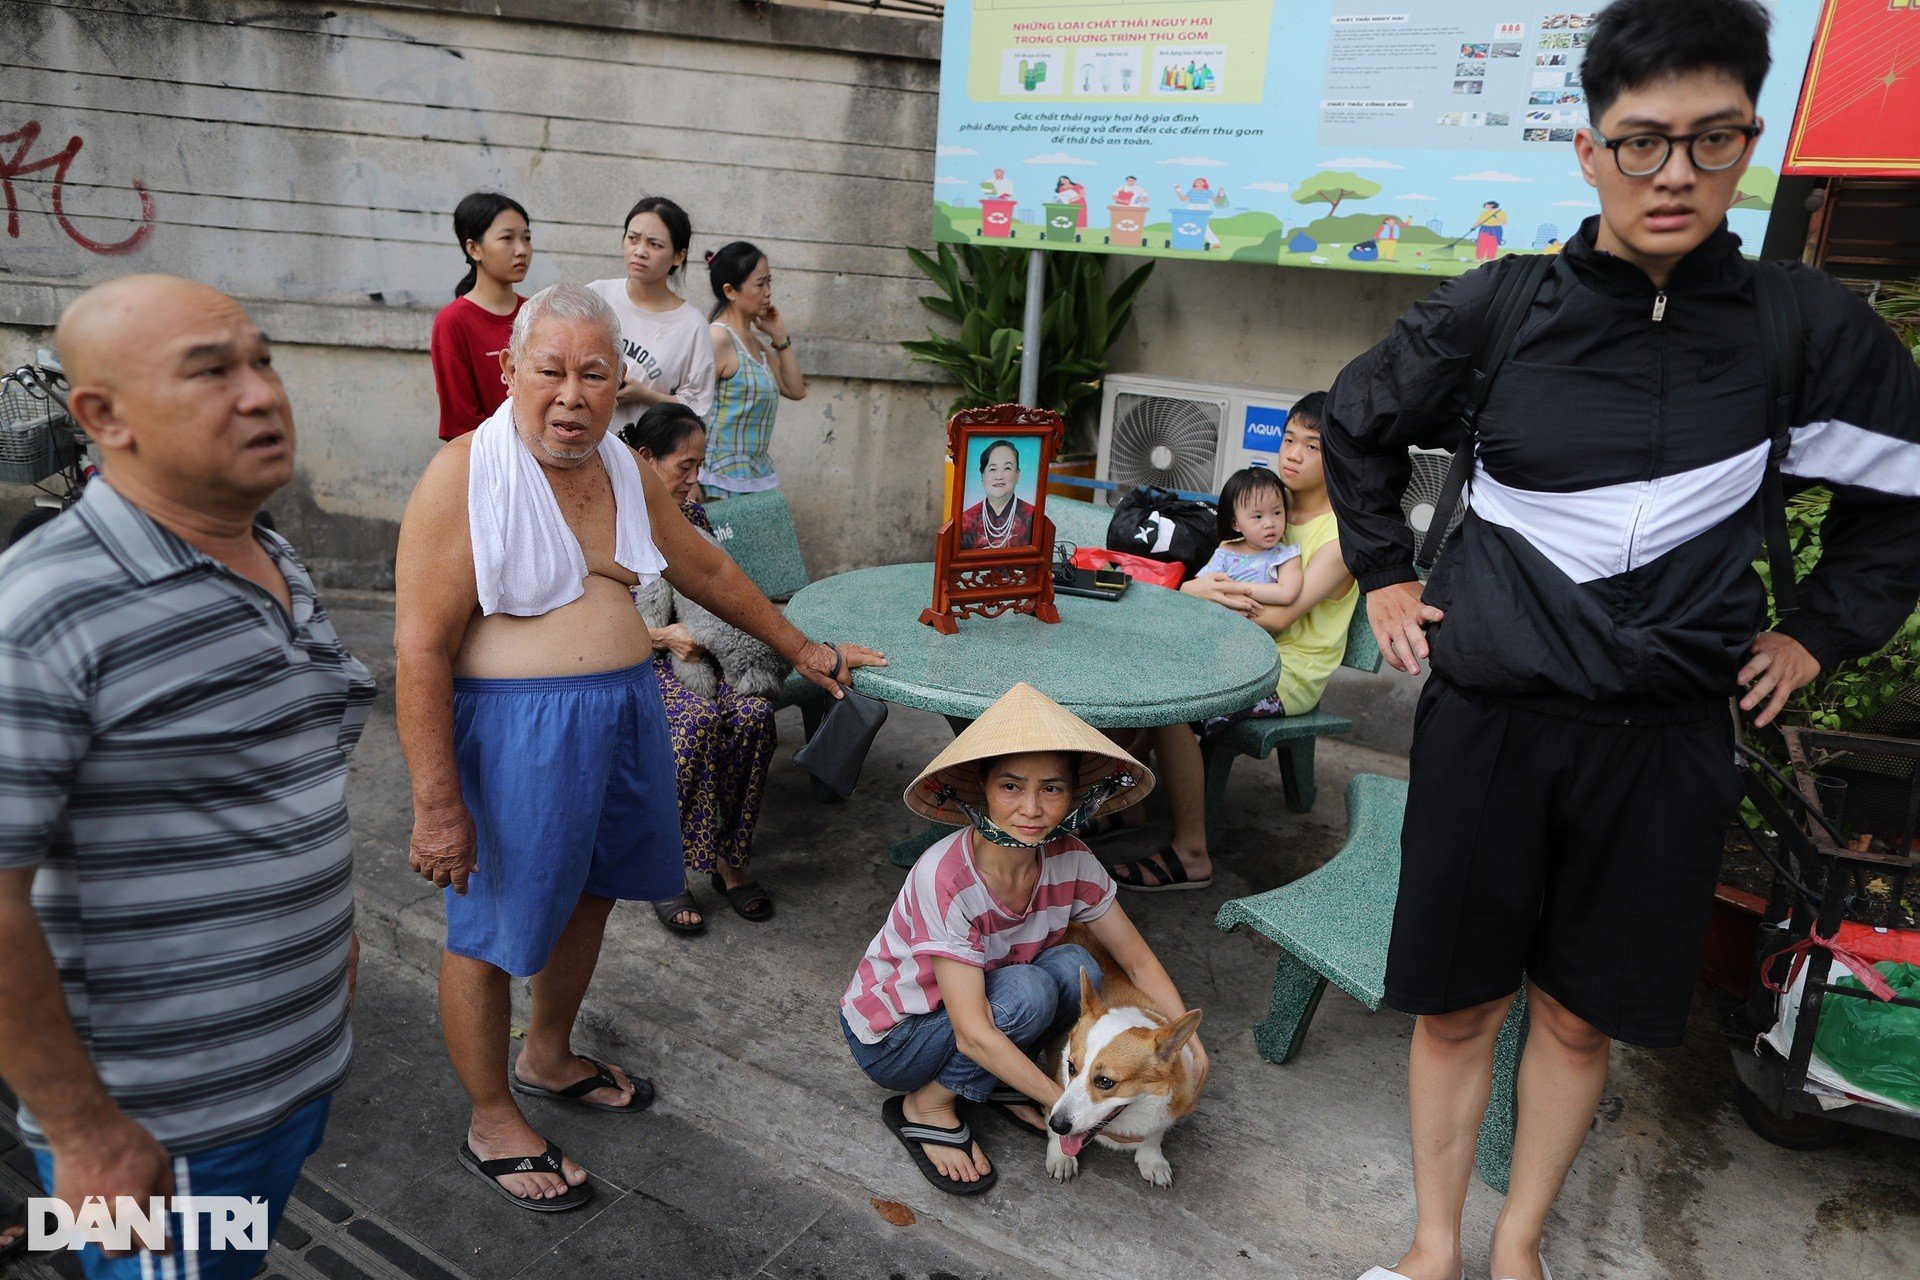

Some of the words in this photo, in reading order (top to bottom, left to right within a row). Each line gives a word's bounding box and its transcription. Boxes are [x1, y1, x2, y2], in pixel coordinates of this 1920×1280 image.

[1086, 18, 1117, 29] CHẤT
[1121, 17, 1148, 28] THẢI
[1151, 18, 1186, 27] NGUY
[1190, 17, 1213, 28] HẠI
[1015, 35, 1054, 43] TRONG
[1056, 34, 1108, 43] CHƯƠNG
[1110, 33, 1146, 41] TRÌNH
[1150, 32, 1175, 41] THU
[1177, 31, 1209, 41] GOM
[1014, 112, 1033, 120] Các
[1035, 112, 1058, 120] chất
[1061, 112, 1082, 120] thải
[1084, 114, 1111, 123] nguy
[1114, 113, 1132, 122] hại
[1134, 113, 1149, 122] hộ
[1152, 114, 1170, 123] gia
[1172, 113, 1199, 122] đình
[959, 122, 982, 131] phải
[984, 123, 1008, 131] được
[1010, 124, 1038, 132] phân
[1040, 124, 1060, 133] loại
[1062, 125, 1091, 134] riêng
[1093, 125, 1106, 133] và
[1109, 125, 1133, 133] đem
[1135, 124, 1157, 134] đến
[1159, 126, 1179, 134] các
[1180, 125, 1210, 135] điểm
[1212, 127, 1233, 135] thu
[1235, 128, 1264, 137] gom
[1051, 134, 1065, 143] để
[1066, 135, 1088, 144] thải
[1123, 137, 1154, 146] toàn.
[1247, 422, 1282, 437] AQUA
